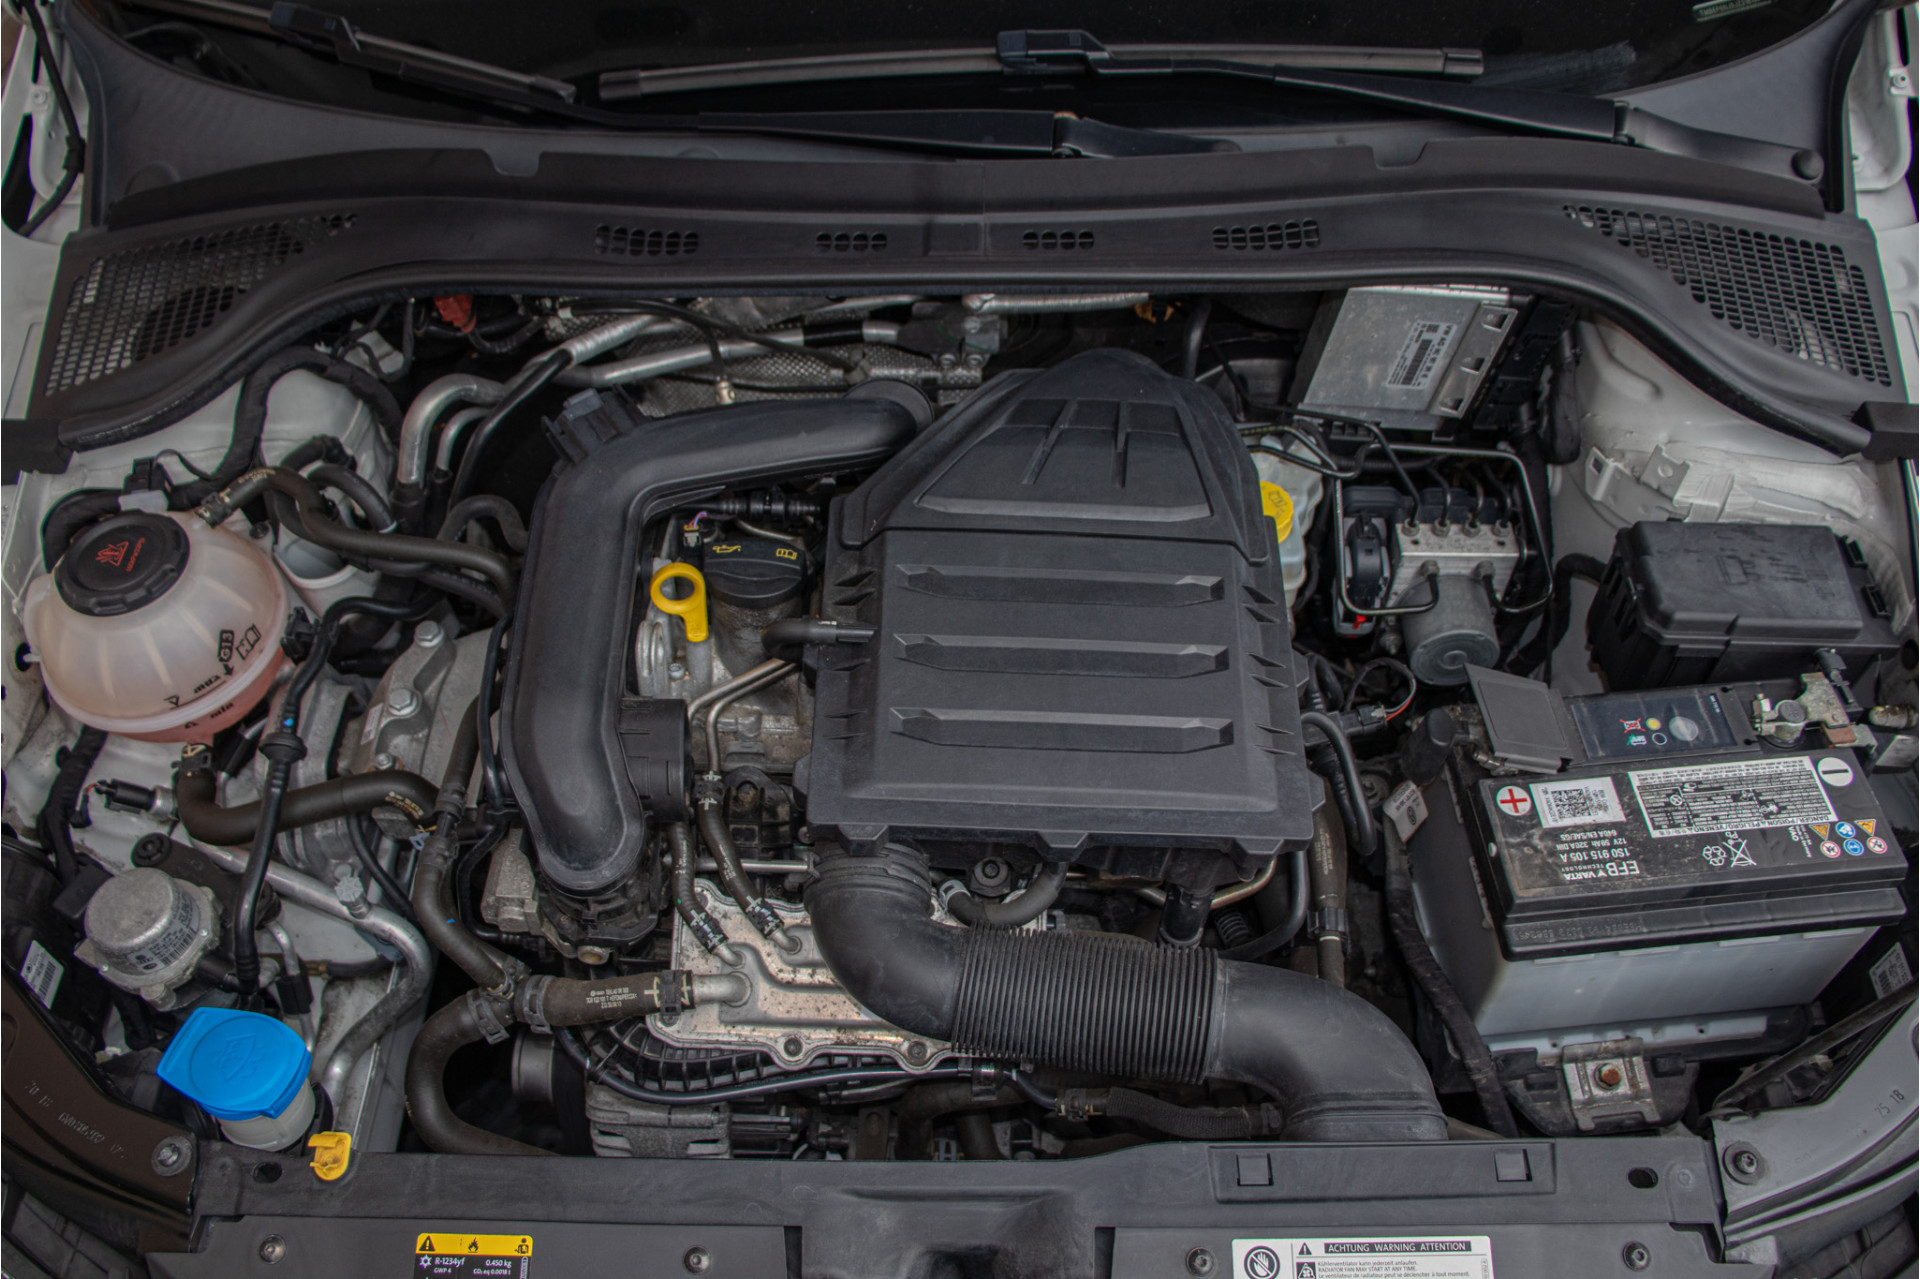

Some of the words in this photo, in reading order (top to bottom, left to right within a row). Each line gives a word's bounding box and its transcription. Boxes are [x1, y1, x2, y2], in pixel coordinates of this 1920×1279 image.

[220, 632, 233, 660] G13
[1725, 831, 1739, 839] Pb
[1613, 837, 1628, 846] 12V
[1559, 853, 1568, 863] A
[1569, 851, 1589, 862] 105
[1590, 849, 1610, 860] 915
[1561, 863, 1605, 872] TECHNOLOGY
[1605, 860, 1640, 877] EFB
[1563, 870, 1597, 880] VARTA
[1890, 1089, 1905, 1103] 18
[1328, 1243, 1370, 1253] ACHTUNG
[1374, 1243, 1416, 1252] WARNING
[1420, 1242, 1466, 1251] ATTENTION
[434, 1256, 466, 1268] R-1234yf
[485, 1259, 503, 1267] 0.450
[503, 1259, 512, 1268] kg
